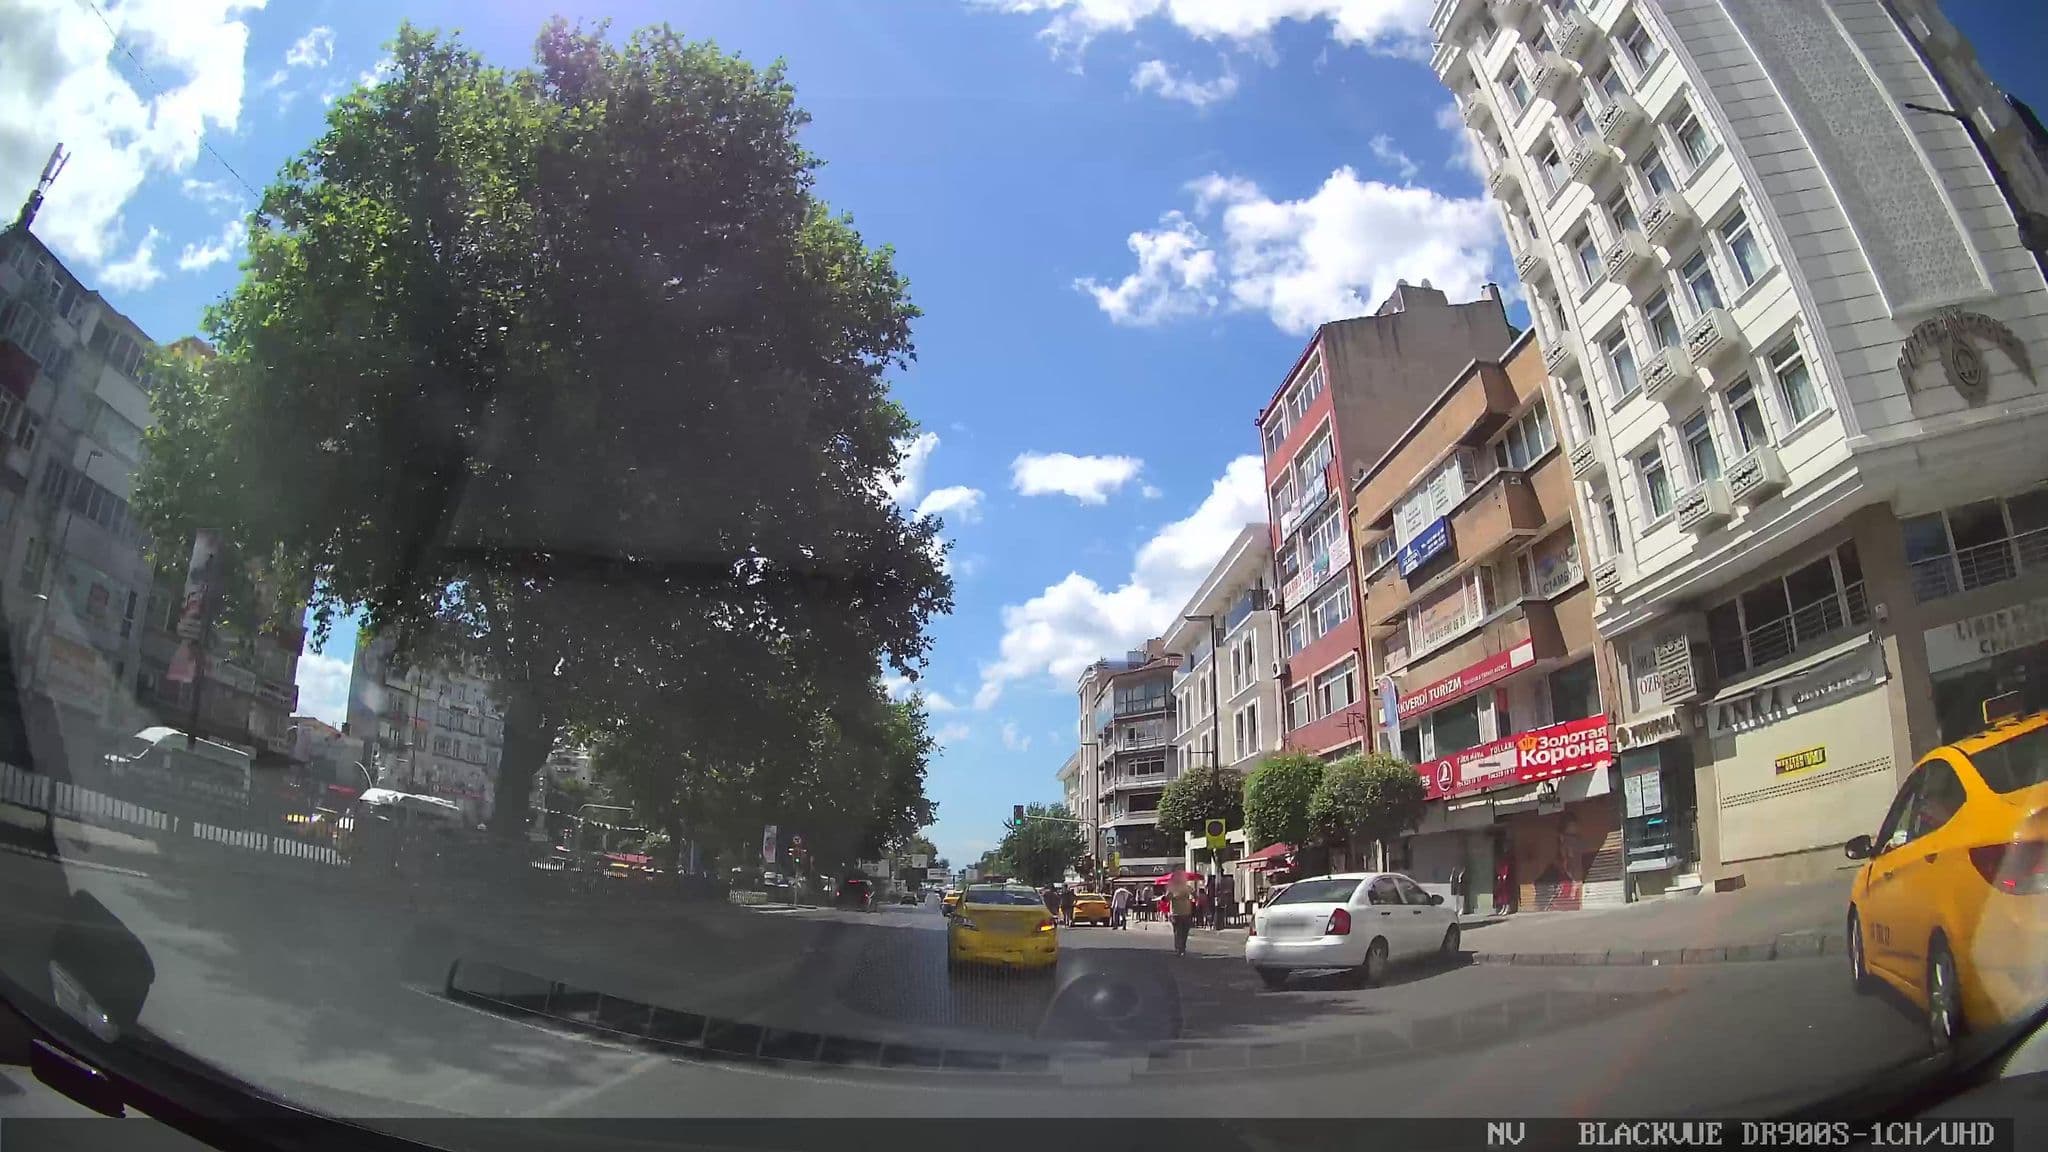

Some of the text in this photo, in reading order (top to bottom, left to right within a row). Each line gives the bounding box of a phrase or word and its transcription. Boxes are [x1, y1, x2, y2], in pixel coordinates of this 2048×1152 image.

[1428, 676, 1462, 702] TURİZM
[1538, 725, 1607, 749] Золотая
[1521, 737, 1609, 768] Корона
